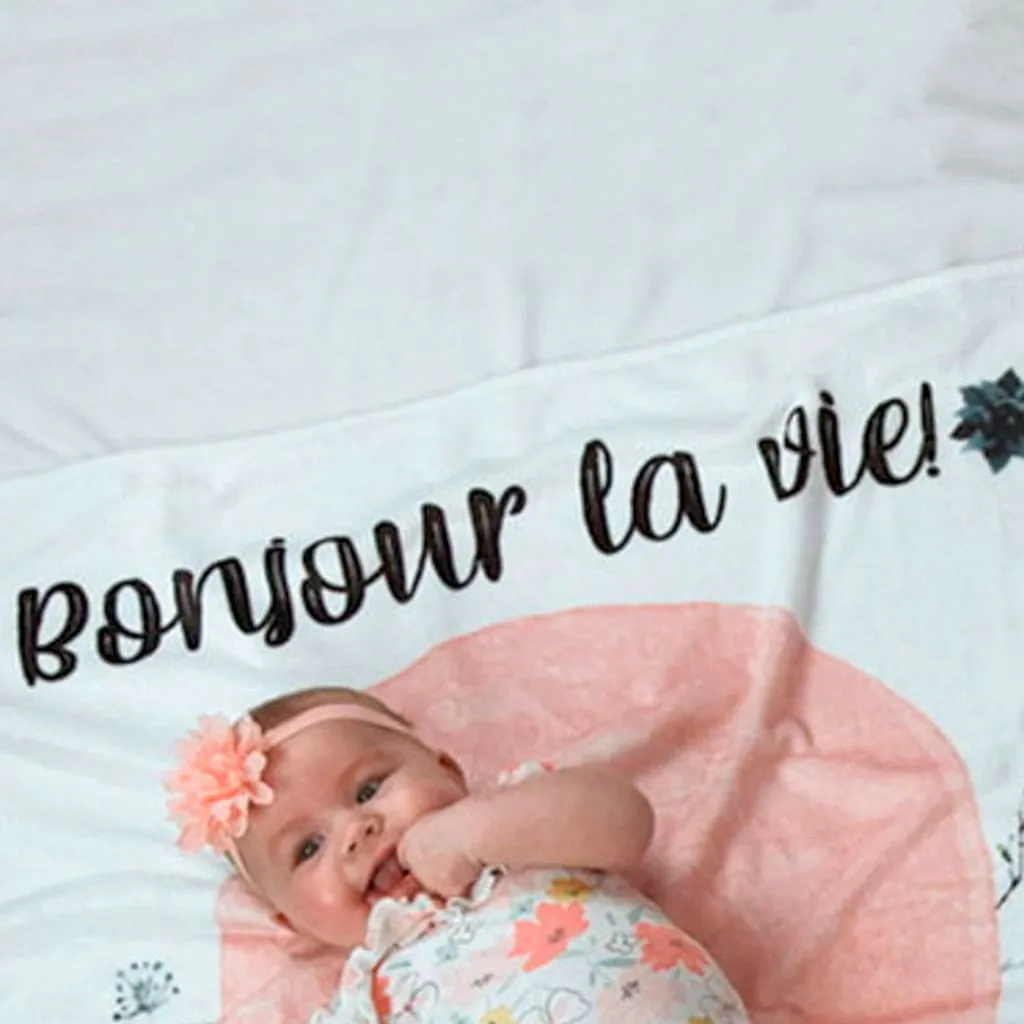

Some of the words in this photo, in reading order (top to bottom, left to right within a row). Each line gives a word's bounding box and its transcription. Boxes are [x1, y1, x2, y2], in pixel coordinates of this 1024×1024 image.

[18, 485, 526, 687] Bonjour
[580, 439, 727, 555] la
[757, 382, 940, 501] vie!
